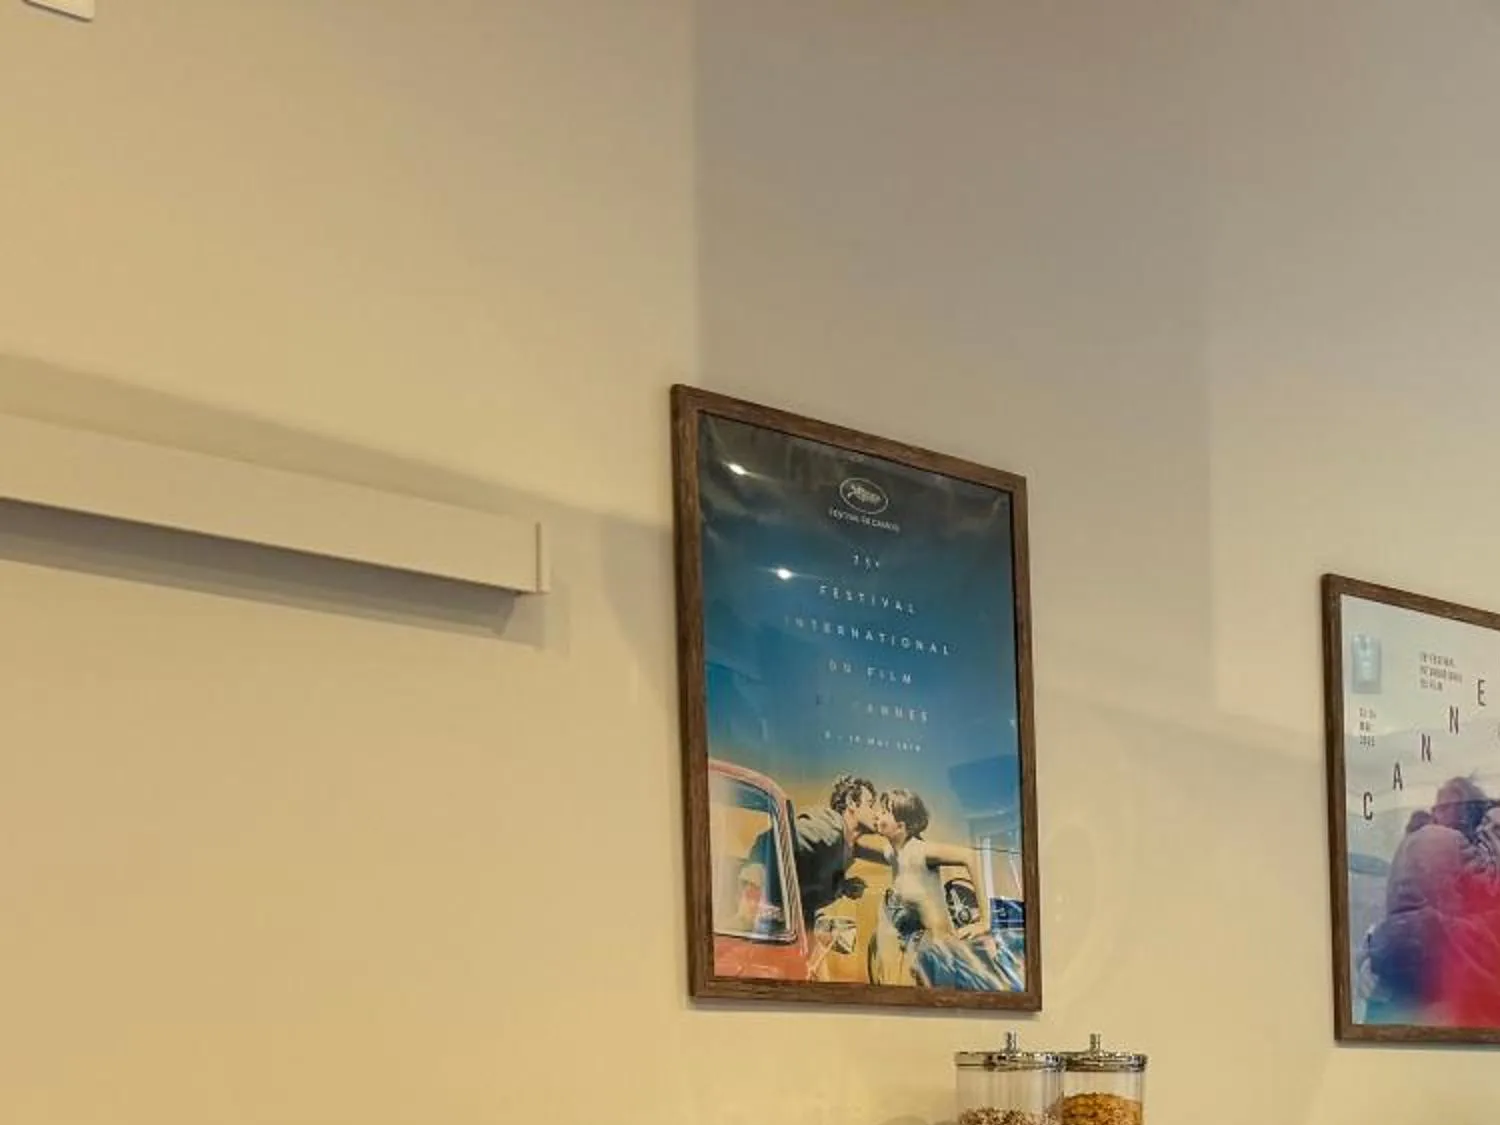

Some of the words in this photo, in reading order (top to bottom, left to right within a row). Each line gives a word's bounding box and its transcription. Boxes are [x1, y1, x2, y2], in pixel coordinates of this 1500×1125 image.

[818, 584, 916, 615] FESTIVAL
[784, 615, 950, 656] INTERNATIONAL
[828, 657, 853, 675] DU
[867, 666, 913, 685] FILM
[854, 701, 929, 723] ANNES
